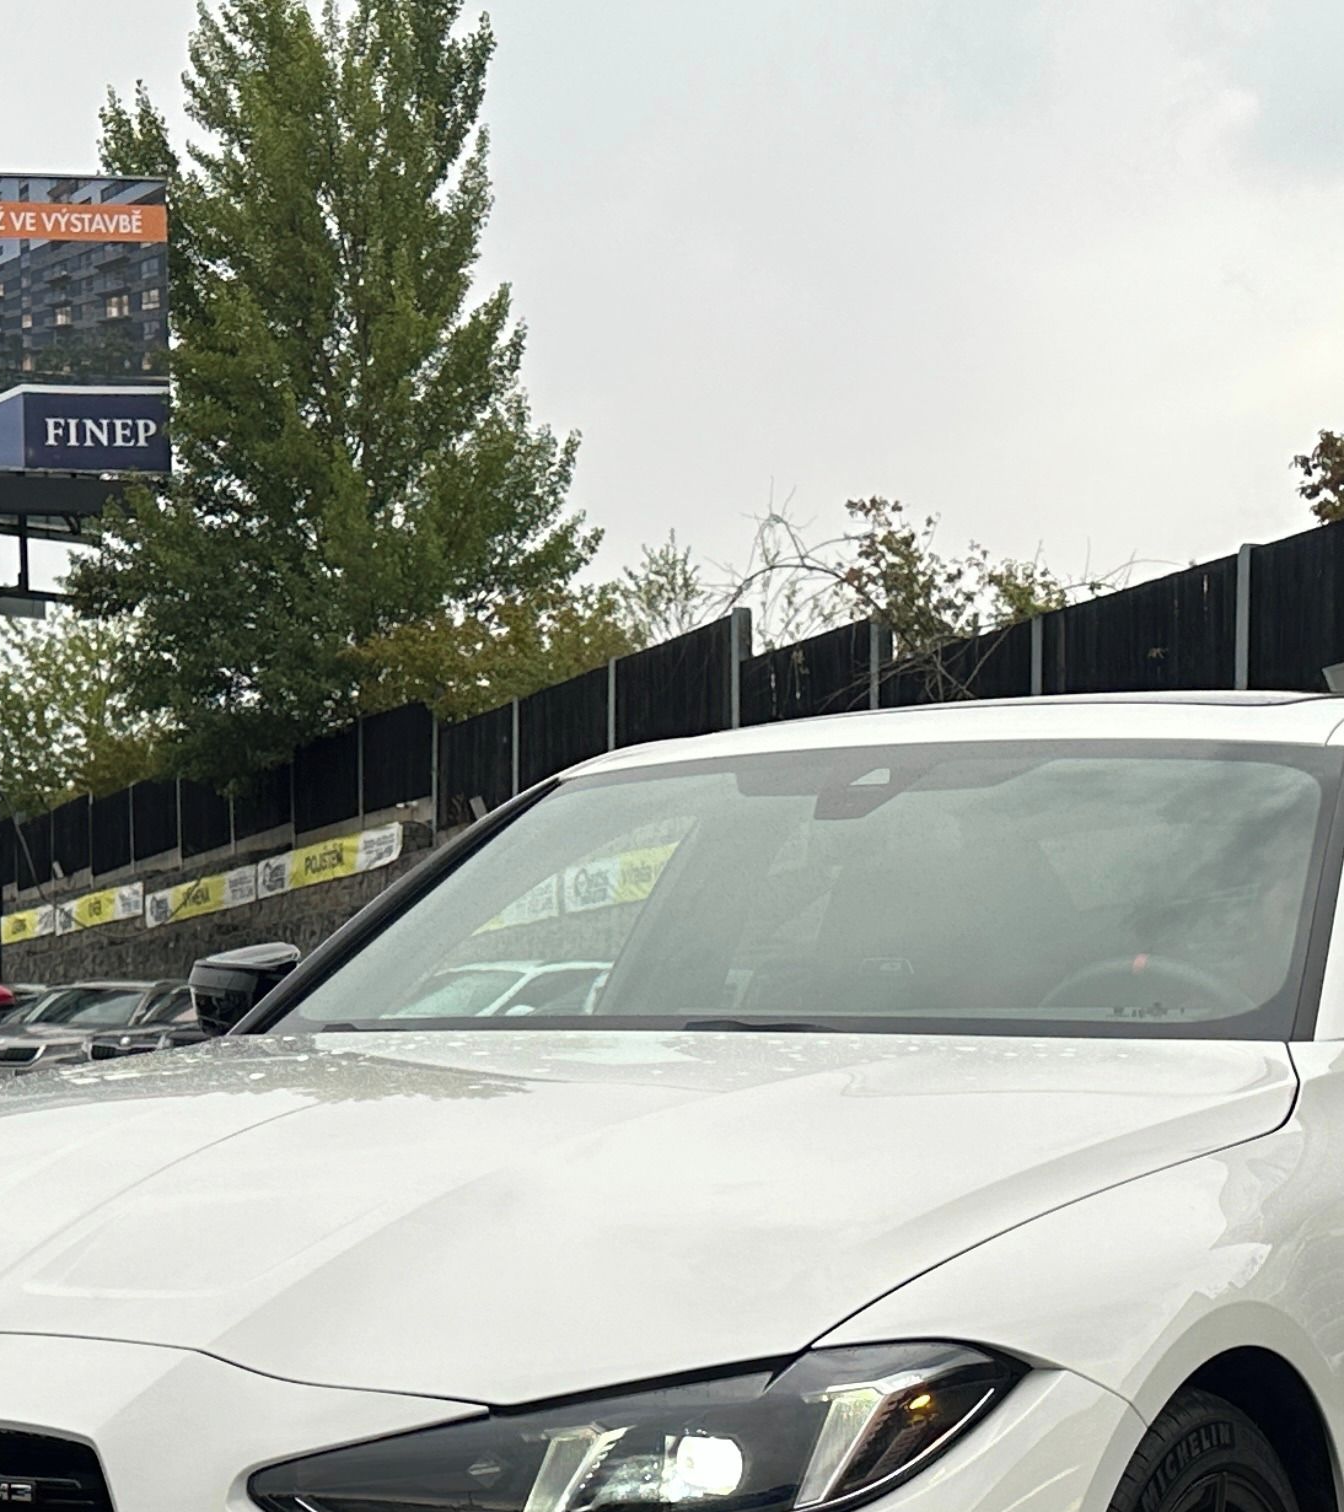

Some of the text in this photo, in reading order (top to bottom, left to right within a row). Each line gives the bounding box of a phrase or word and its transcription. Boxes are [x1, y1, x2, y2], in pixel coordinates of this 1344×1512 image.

[10, 212, 36, 231] VE
[41, 208, 143, 233] VÝSTAVBĚ
[44, 418, 156, 447] FINEP
